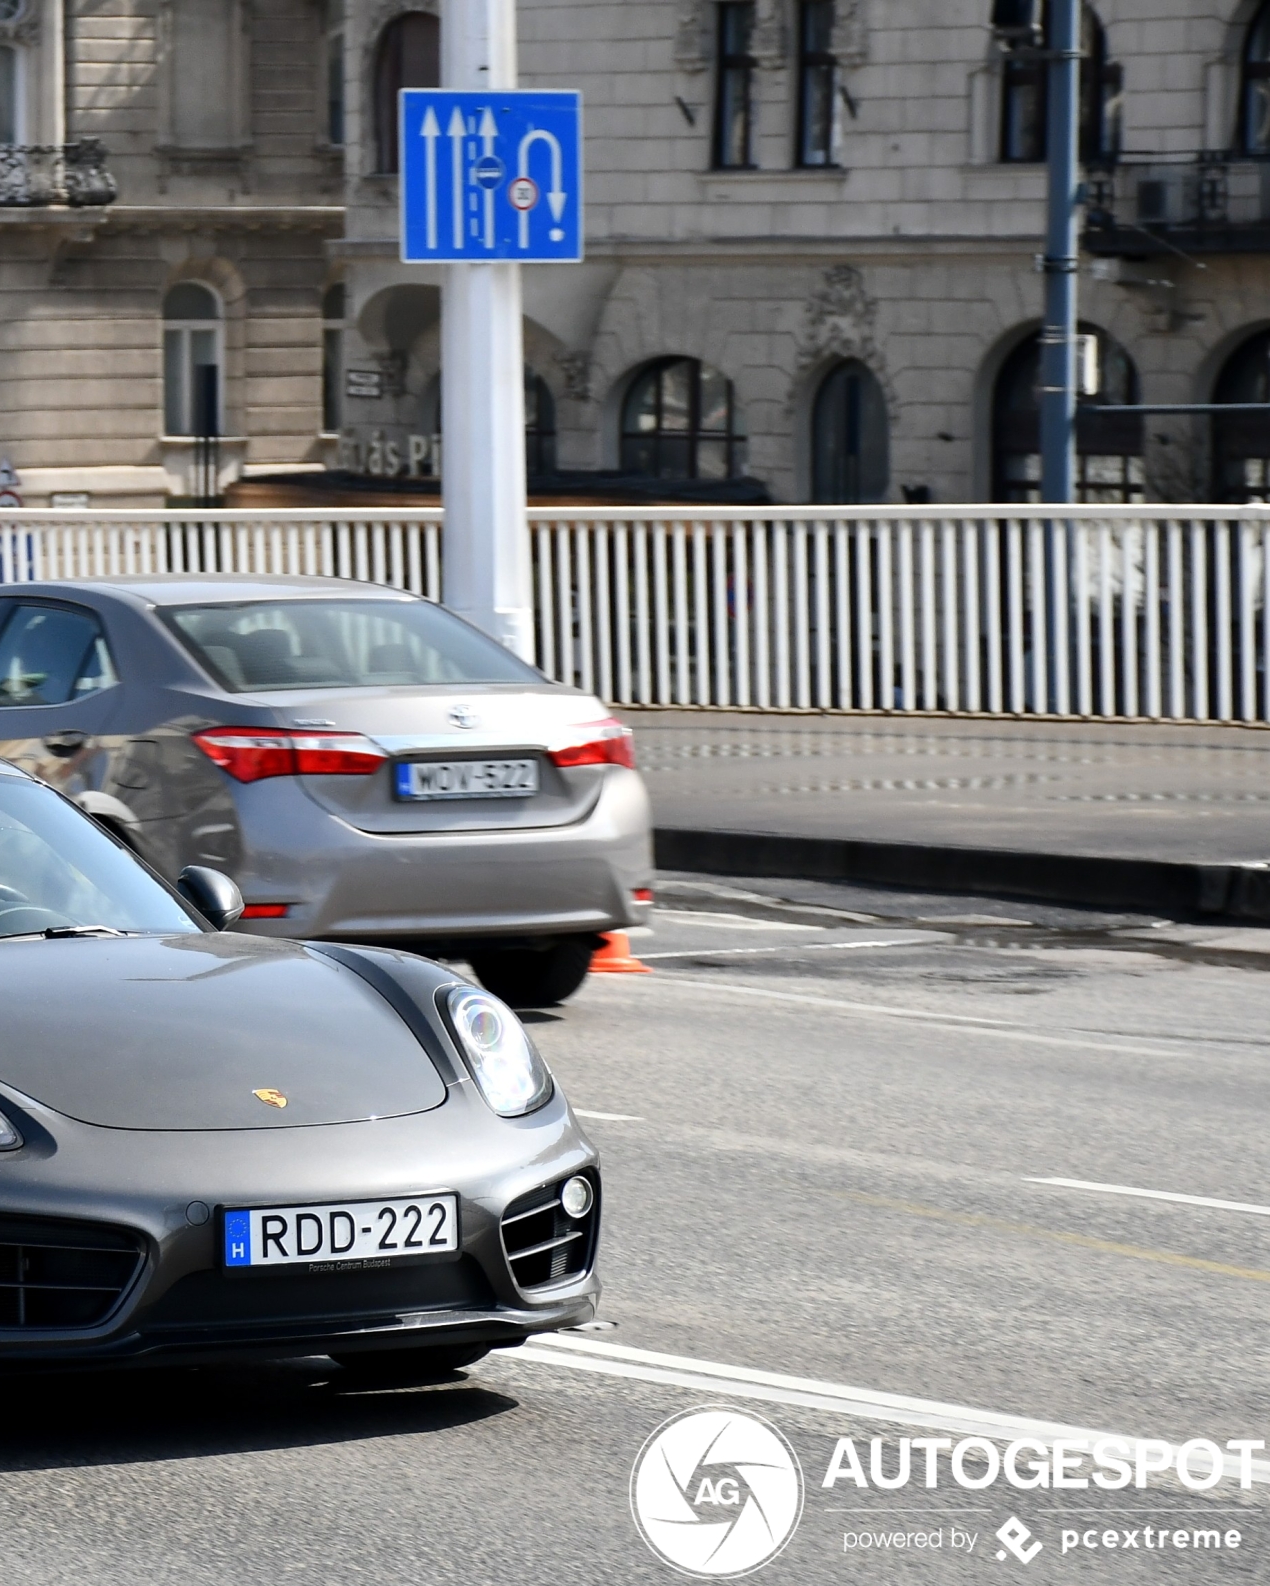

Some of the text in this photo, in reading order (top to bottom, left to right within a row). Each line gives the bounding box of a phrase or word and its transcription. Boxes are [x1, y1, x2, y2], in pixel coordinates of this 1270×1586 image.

[261, 1202, 448, 1259] RDD-222
[232, 1242, 245, 1259] H
[309, 1258, 391, 1273] Porsche Centrum Budapest
